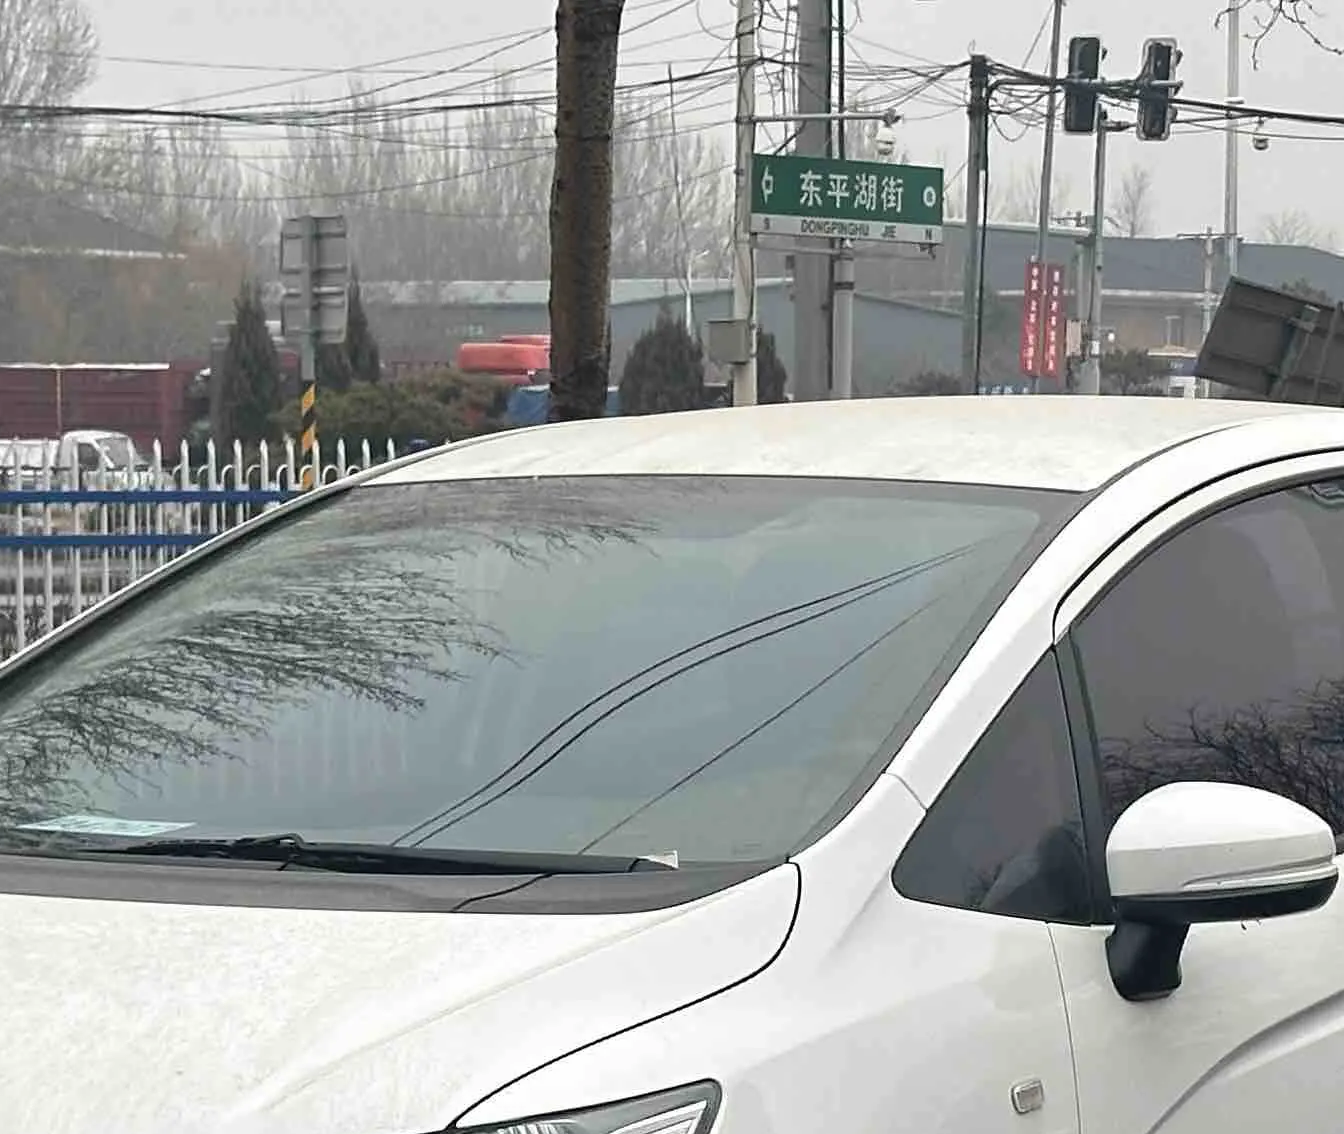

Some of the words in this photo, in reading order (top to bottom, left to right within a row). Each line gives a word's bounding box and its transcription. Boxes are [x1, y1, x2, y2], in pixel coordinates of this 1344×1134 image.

[799, 169, 904, 213] 东平湖街
[800, 218, 871, 237] DONGPINGHU
[923, 227, 933, 241] N
